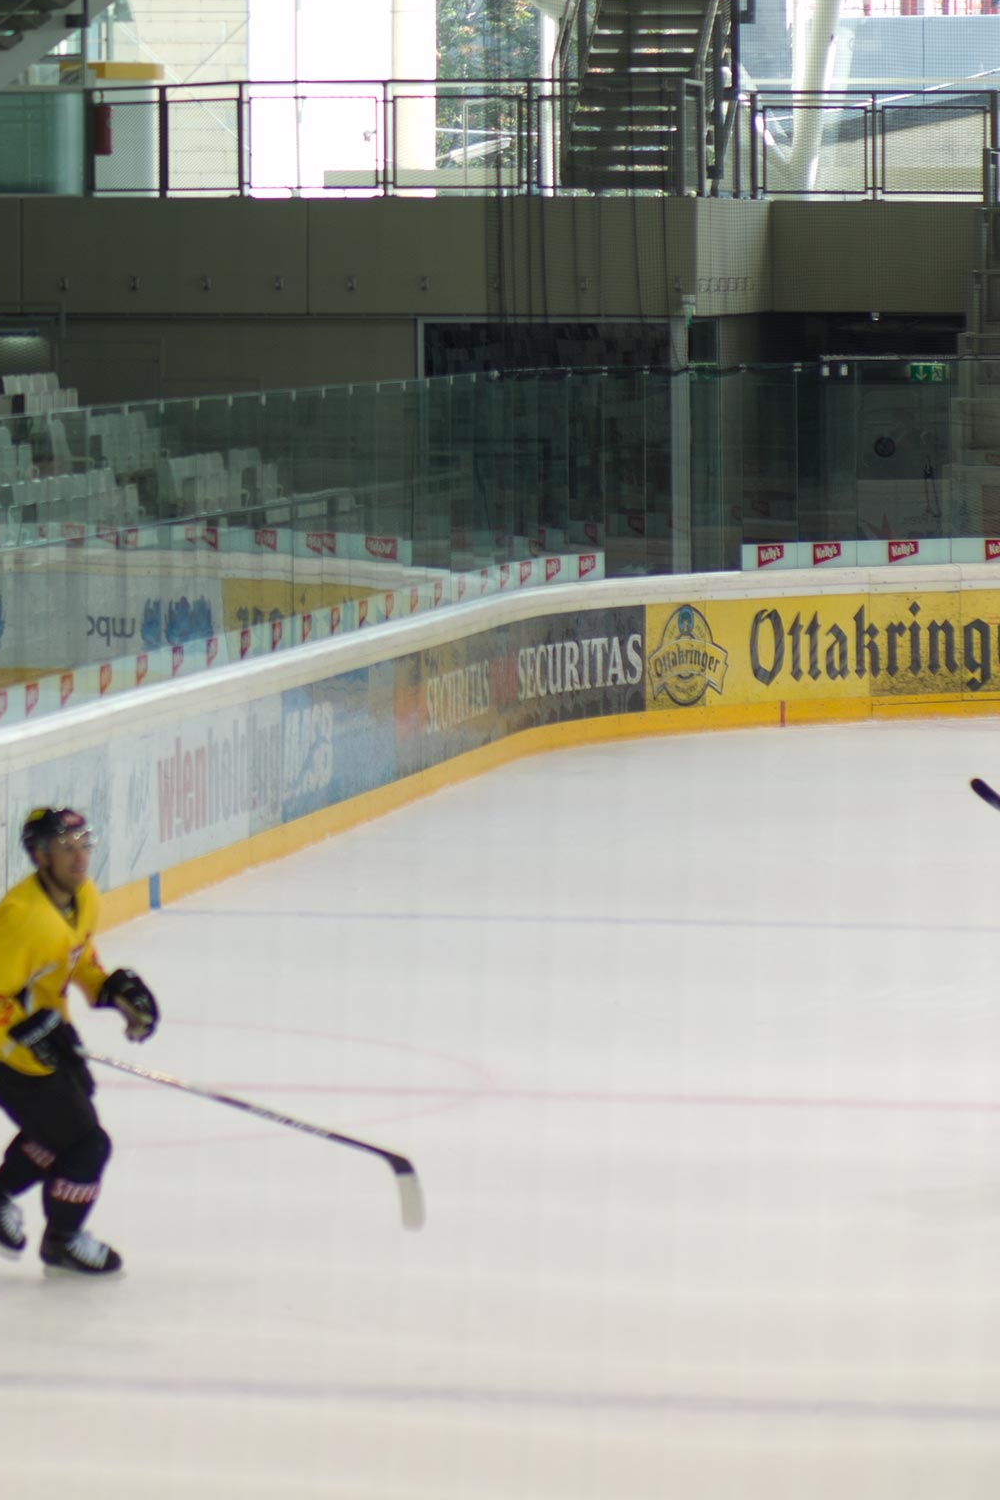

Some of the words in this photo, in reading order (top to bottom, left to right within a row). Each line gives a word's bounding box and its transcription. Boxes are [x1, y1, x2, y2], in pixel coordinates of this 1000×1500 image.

[760, 547, 781, 562] Kelly's
[816, 544, 838, 559] Kelly's
[891, 542, 915, 557] Kelly's
[749, 601, 1000, 692] Ottakring
[517, 634, 643, 700] SECURITAS
[654, 643, 721, 678] Ottakringer
